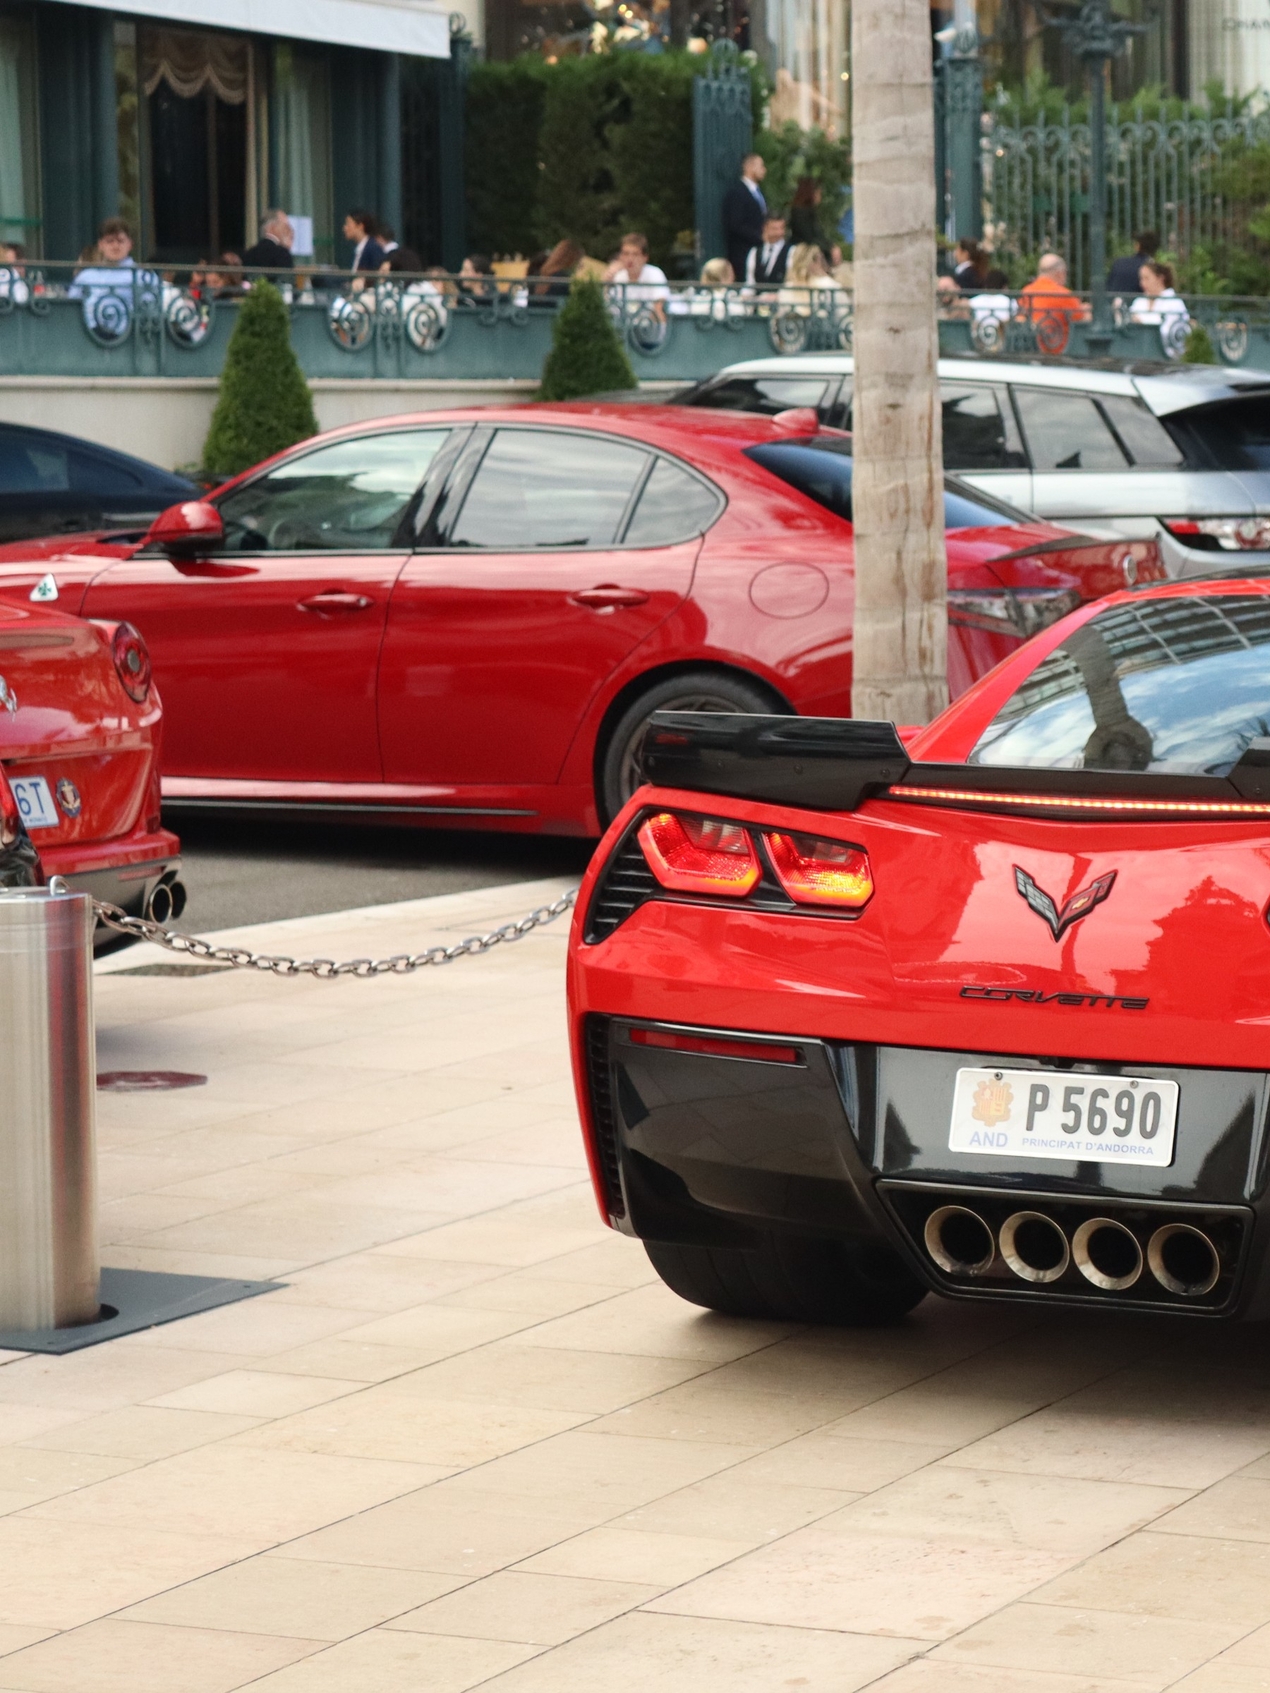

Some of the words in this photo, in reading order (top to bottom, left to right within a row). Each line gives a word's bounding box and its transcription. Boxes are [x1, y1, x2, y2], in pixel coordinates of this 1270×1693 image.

[959, 985, 1149, 1010] CORVETTE
[1025, 1083, 1050, 1132] P
[1060, 1086, 1162, 1140] 5690
[968, 1131, 1009, 1148] AND
[1021, 1137, 1082, 1150] PRINCIPAT
[1085, 1141, 1154, 1156] D'ANDORRA
